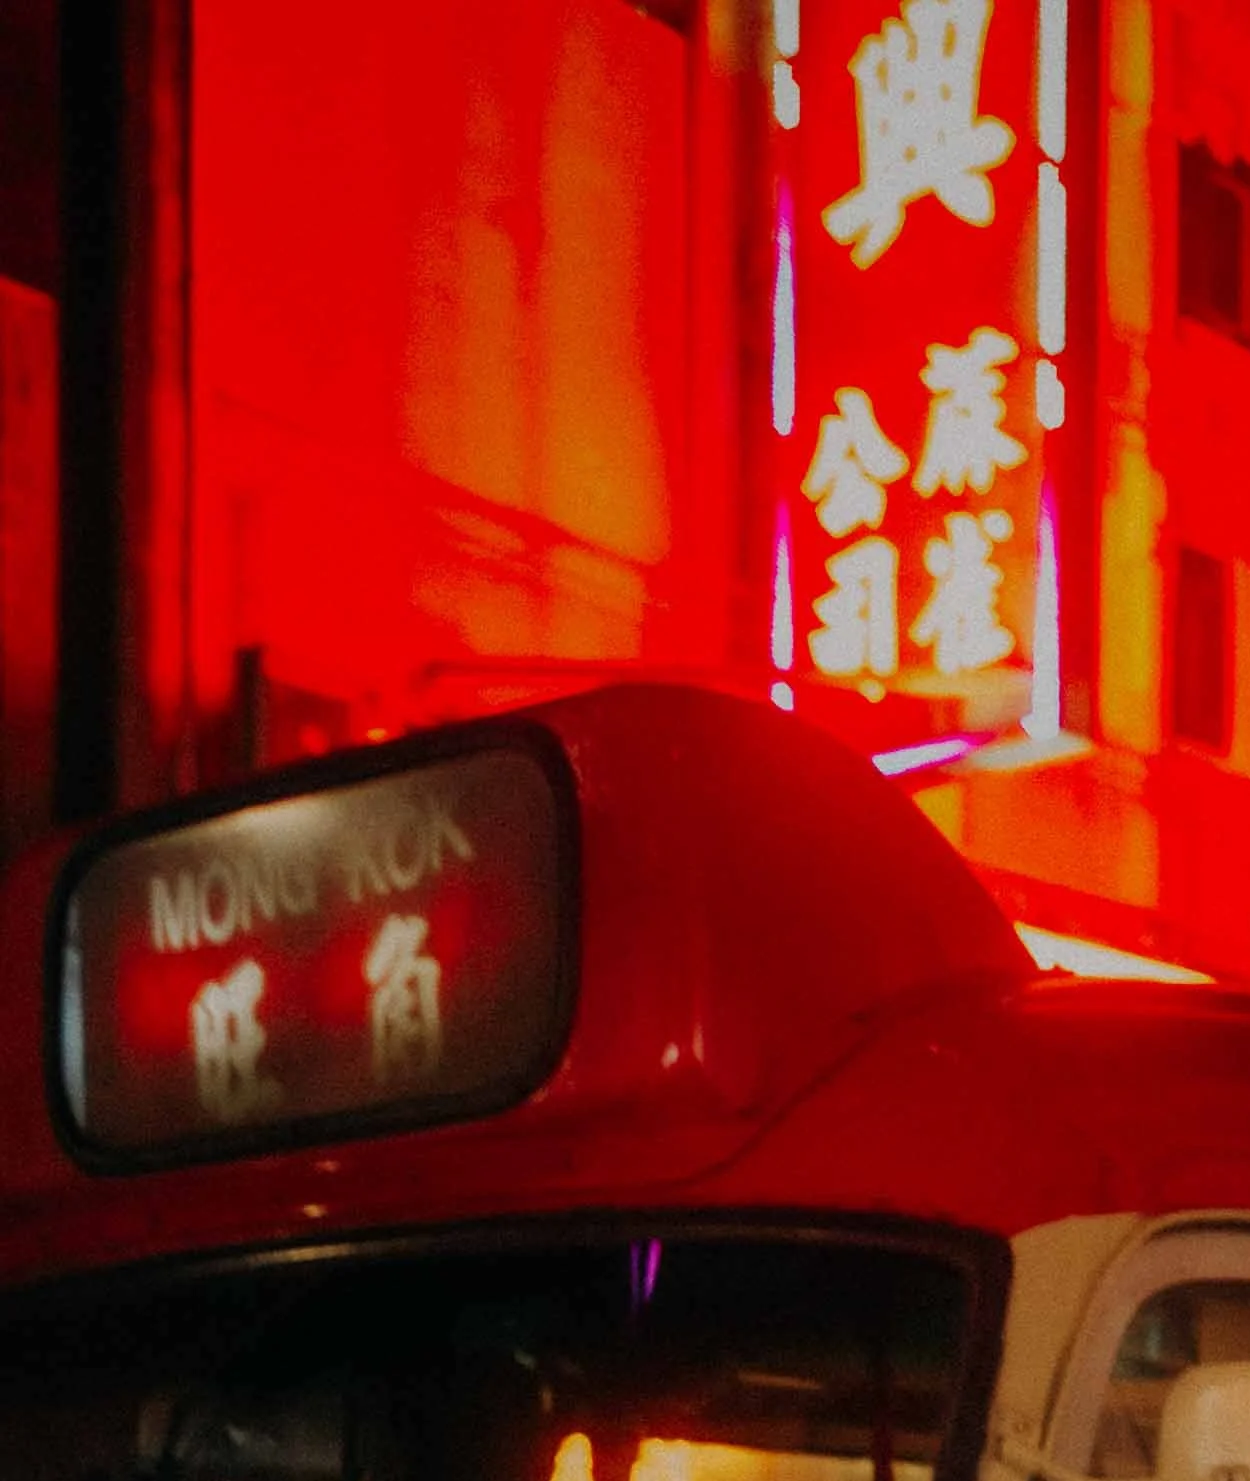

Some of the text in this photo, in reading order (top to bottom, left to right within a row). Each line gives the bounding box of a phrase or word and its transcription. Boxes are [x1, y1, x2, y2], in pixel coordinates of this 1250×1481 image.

[801, 386, 908, 677] 公司
[149, 802, 476, 953] MONG KOK
